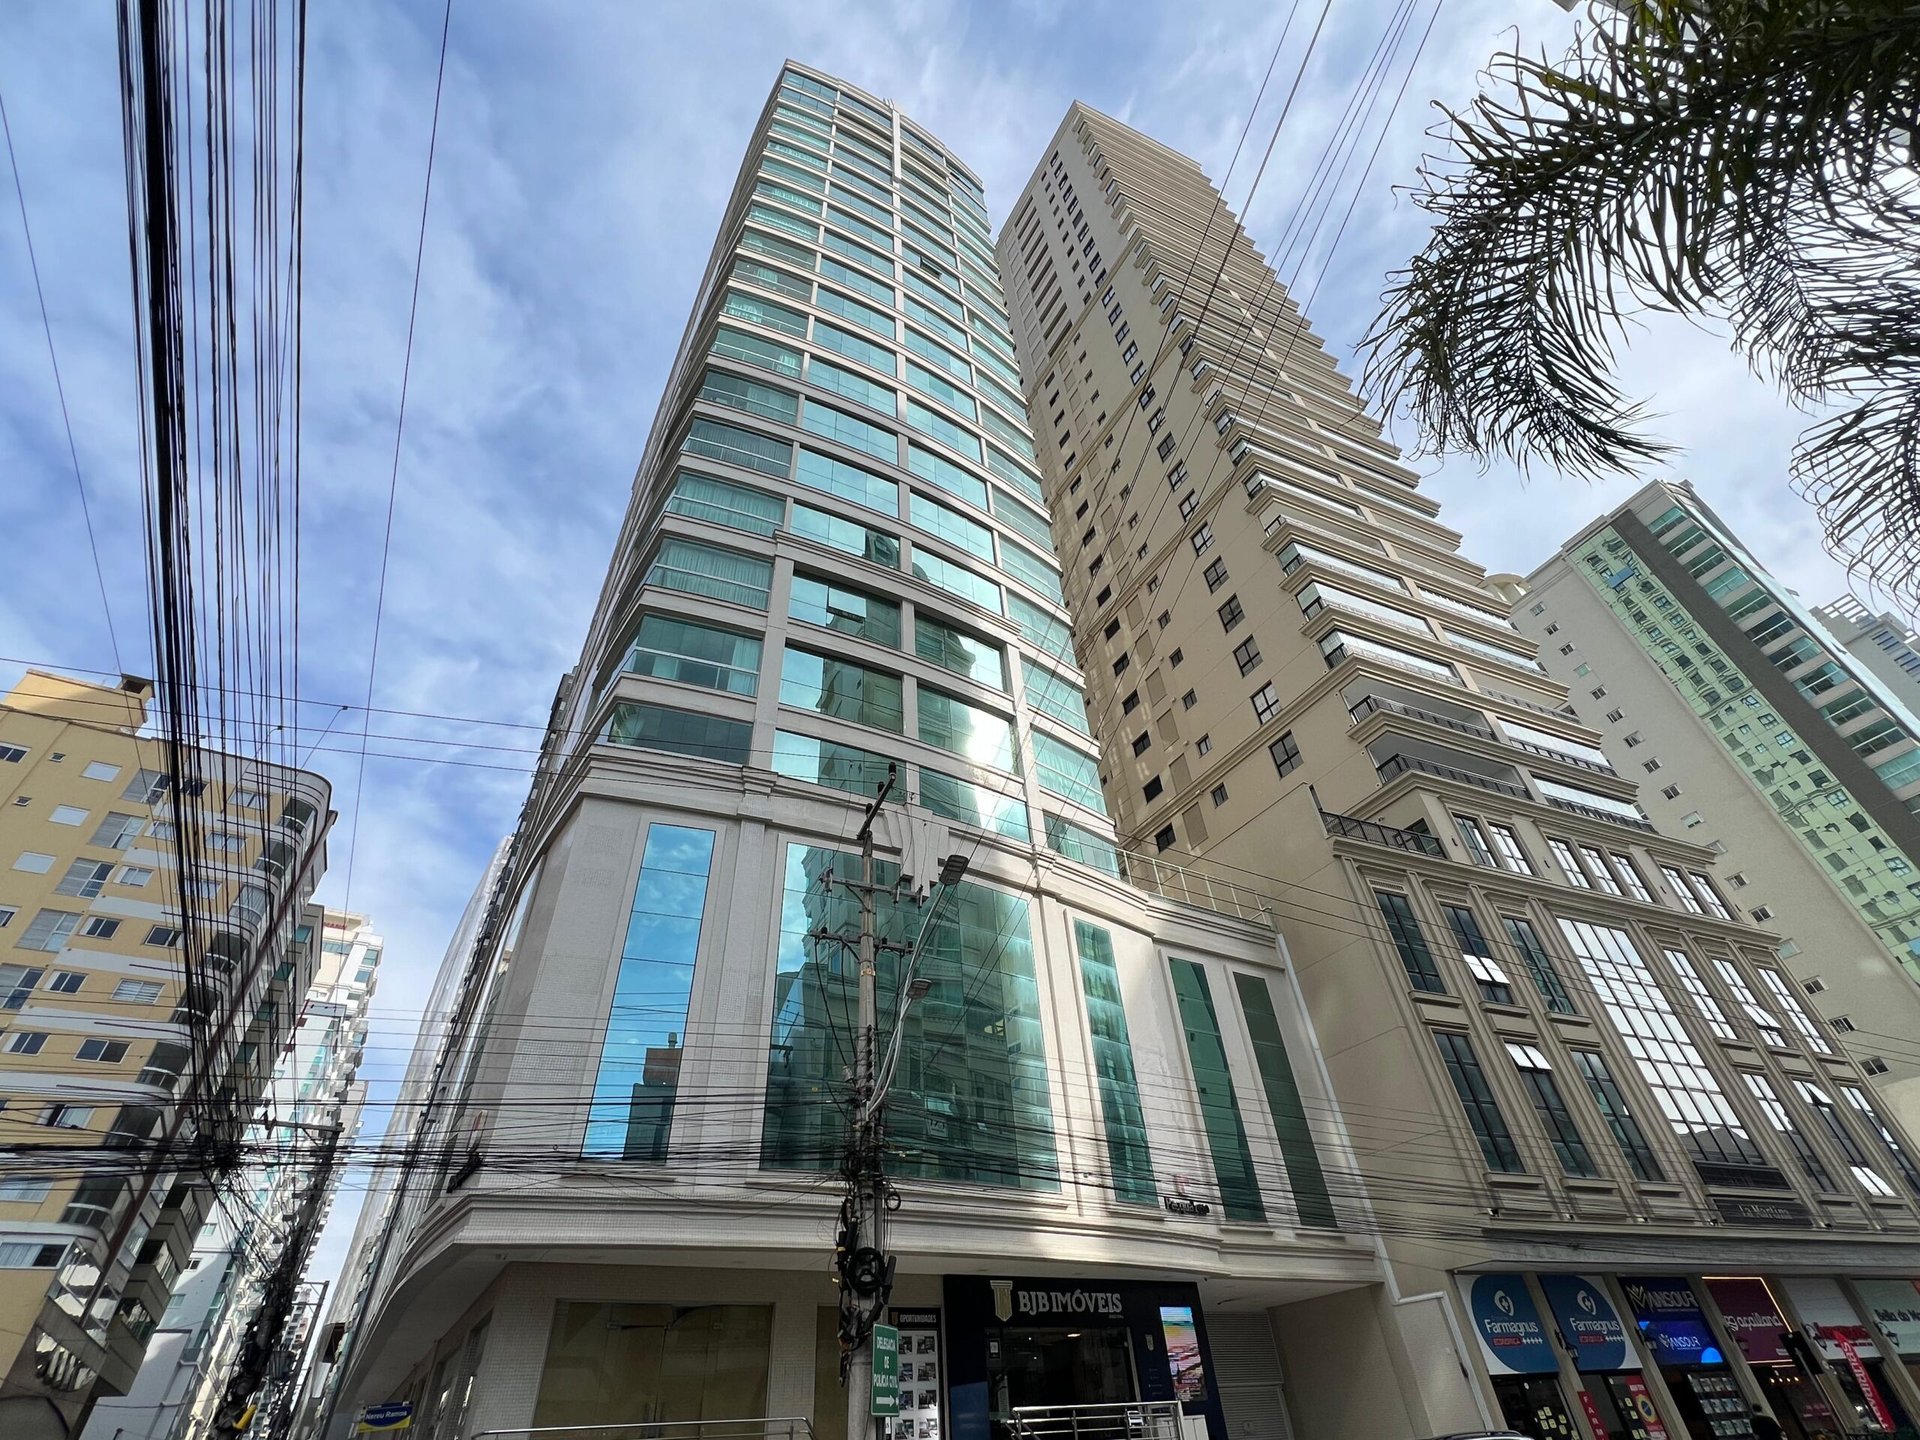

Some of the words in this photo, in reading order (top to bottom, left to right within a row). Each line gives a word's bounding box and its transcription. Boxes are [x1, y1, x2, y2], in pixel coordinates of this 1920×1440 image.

[1018, 1290, 1050, 1316] BJB
[1050, 1288, 1122, 1313] IMÓVEIS
[899, 1314, 937, 1323] OPORTUNIDADES
[1570, 1317, 1620, 1335] Farmagnus
[1485, 1319, 1539, 1336] Farmagnus
[876, 1336, 896, 1351] DELEGACIA
[883, 1356, 890, 1369] DE
[873, 1372, 889, 1388] POLÍCIA
[889, 1375, 898, 1389] CIVIL
[1583, 1396, 1605, 1440] FARM
